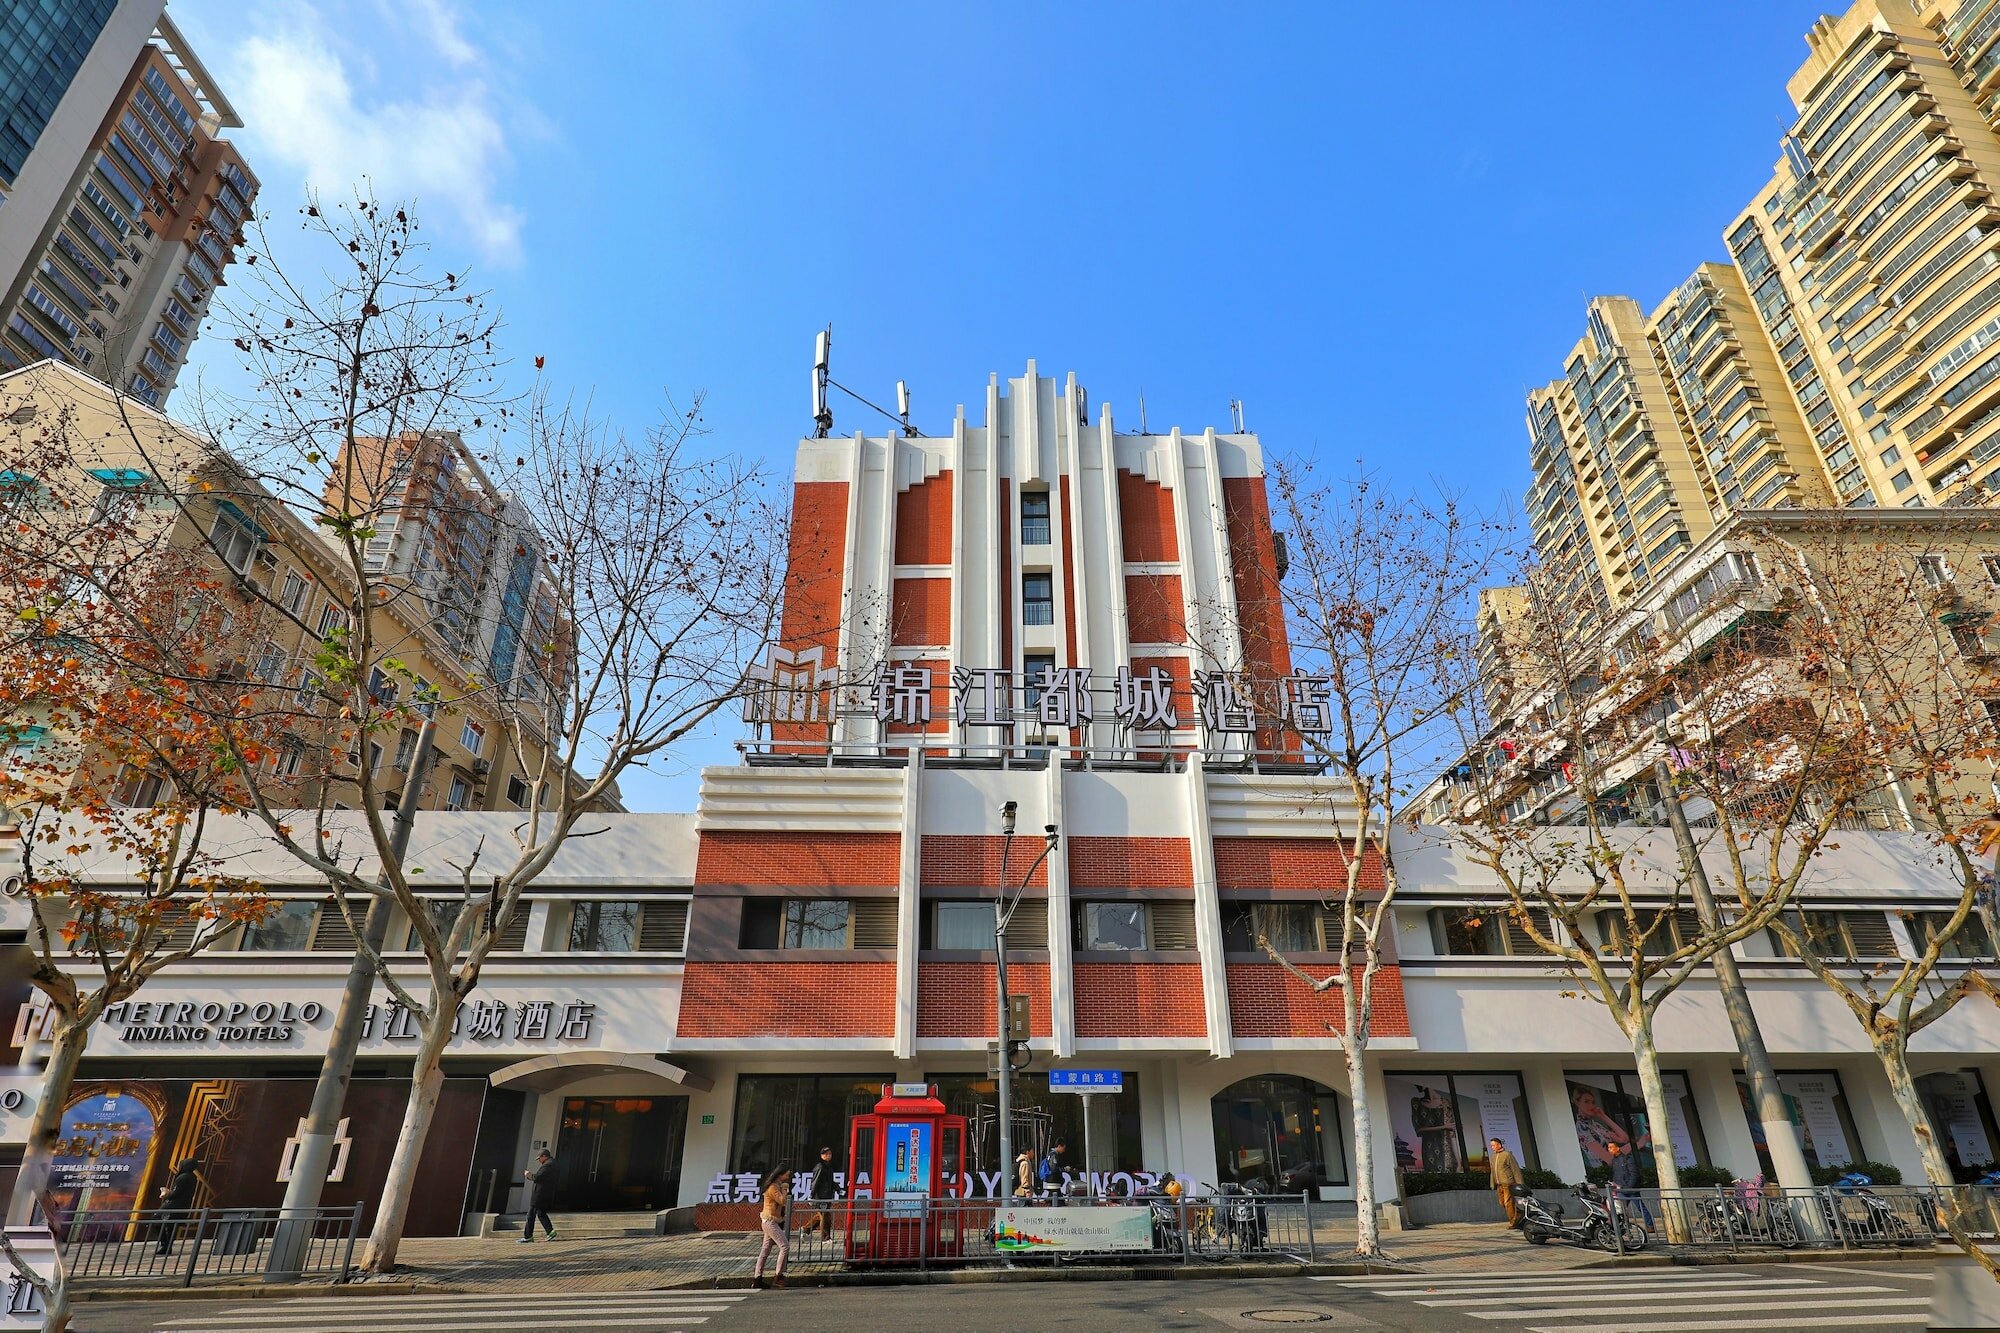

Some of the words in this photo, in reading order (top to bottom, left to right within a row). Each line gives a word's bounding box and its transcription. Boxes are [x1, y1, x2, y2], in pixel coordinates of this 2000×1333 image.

[871, 660, 1332, 733] 锦江都城酒店
[101, 1001, 324, 1024] METROPOLO
[361, 999, 597, 1041] 江城酒店
[119, 1026, 209, 1042] JINJIANG
[215, 1025, 294, 1041] HOTELS
[1068, 1073, 1104, 1083] 蒙自路
[1023, 1217, 1044, 1225] 中国梦
[1047, 1217, 1067, 1225] 我的梦
[1044, 1227, 1110, 1235] 绿水青山就是金山银山
